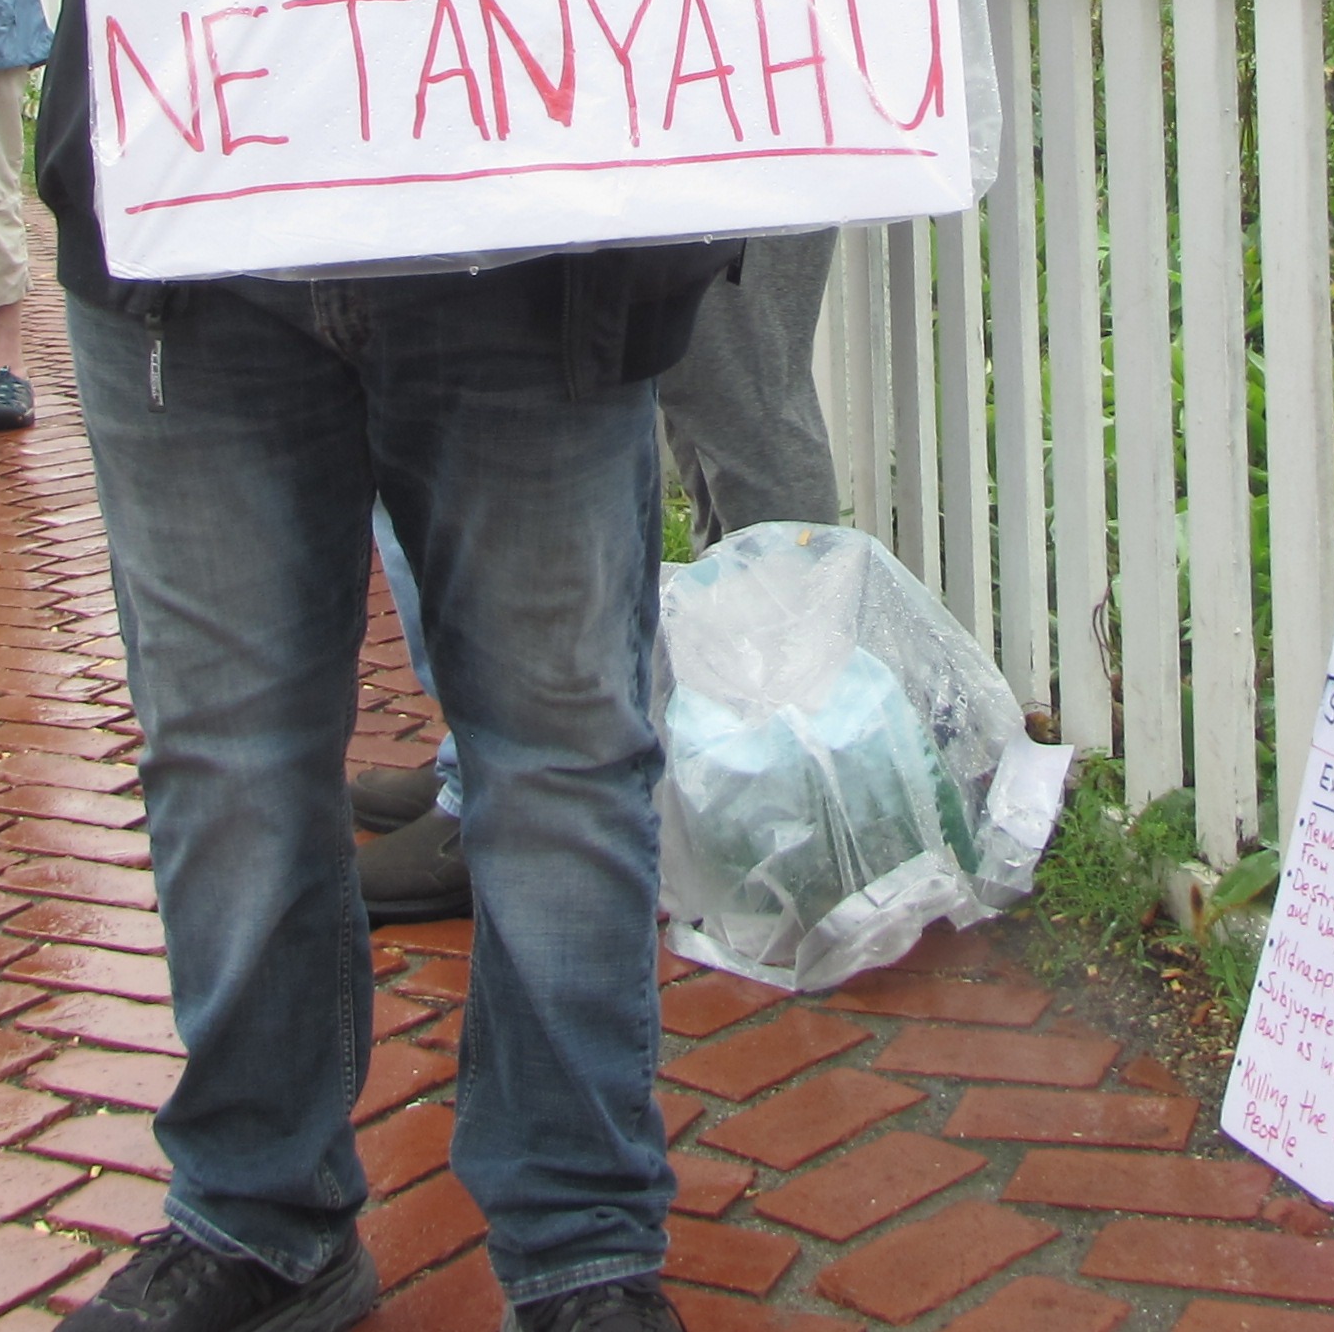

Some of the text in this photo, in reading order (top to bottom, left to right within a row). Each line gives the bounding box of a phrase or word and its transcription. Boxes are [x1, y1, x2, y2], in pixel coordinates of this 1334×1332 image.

[1255, 1003, 1288, 1046] laws
[1297, 1041, 1312, 1061] as
[1261, 971, 1334, 1035] Subjugate
[1241, 1056, 1288, 1127] Killing
[1299, 1090, 1327, 1135] the
